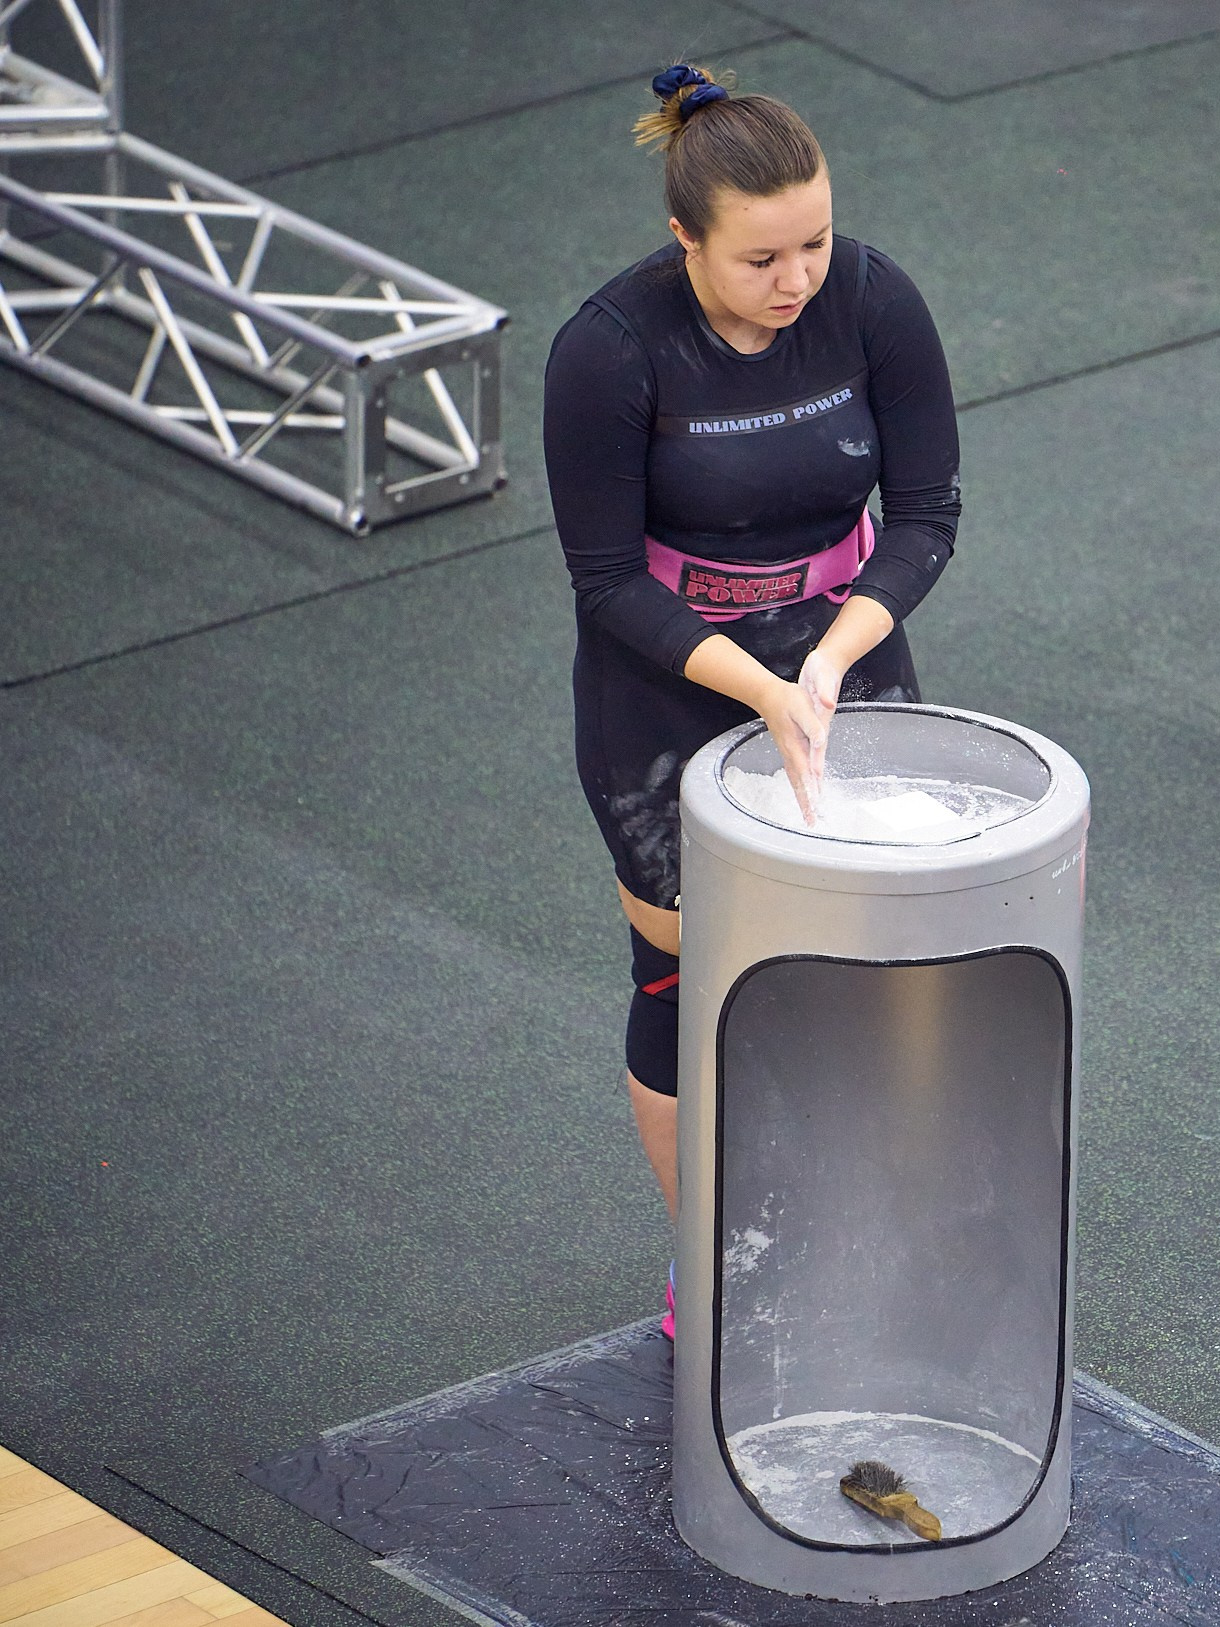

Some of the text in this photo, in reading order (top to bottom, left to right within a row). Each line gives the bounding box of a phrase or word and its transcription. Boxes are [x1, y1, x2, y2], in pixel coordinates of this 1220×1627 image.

[689, 387, 853, 434] UNLIMITED POWER
[688, 569, 802, 589] UNLIMITED
[685, 580, 798, 603] POWER
